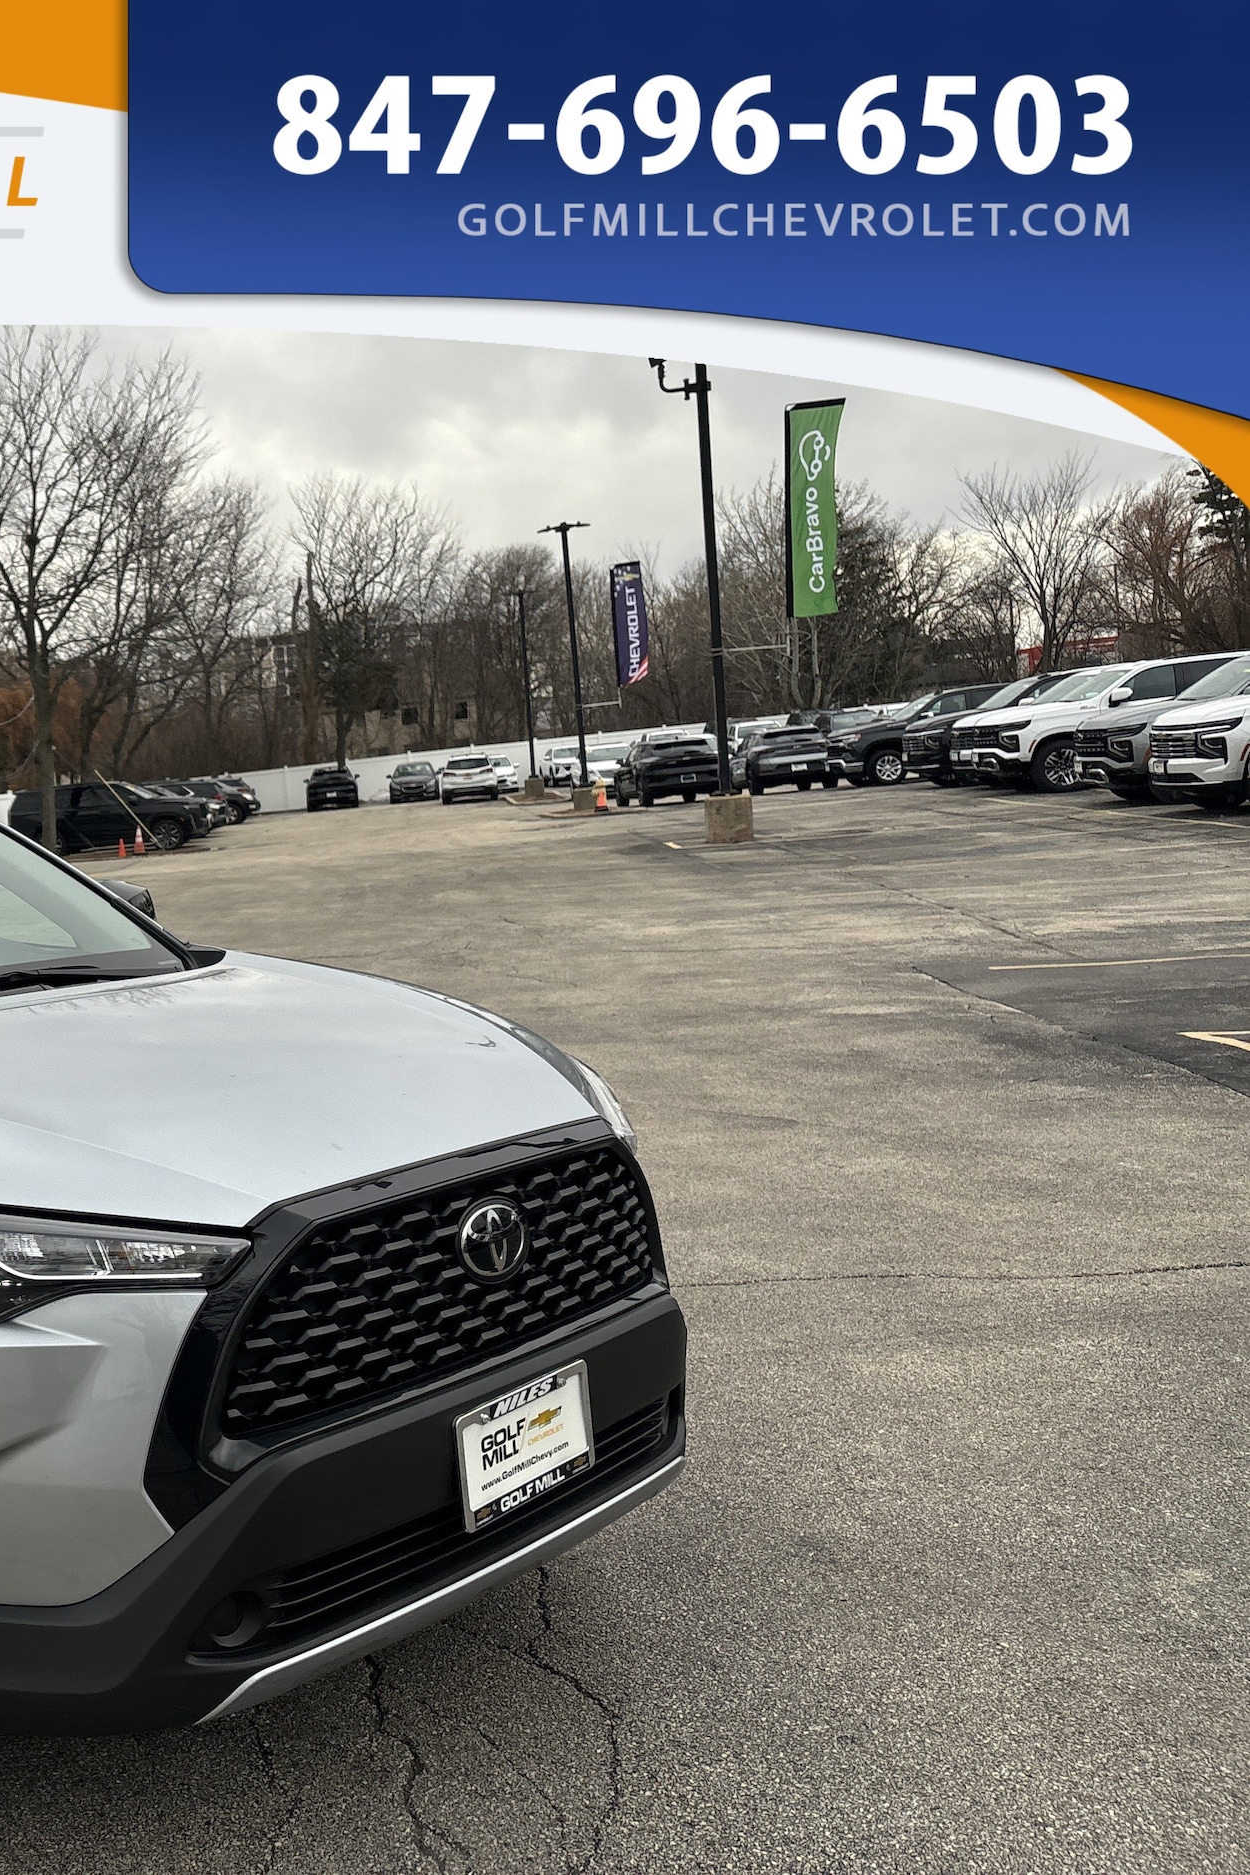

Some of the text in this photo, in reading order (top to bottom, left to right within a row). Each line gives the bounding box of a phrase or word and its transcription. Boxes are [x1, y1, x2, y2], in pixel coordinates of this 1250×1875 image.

[805, 486, 826, 594] CarBravo
[625, 585, 641, 678] CHEVROLET
[493, 1376, 554, 1420] NILES
[481, 1417, 526, 1454] GOLF
[482, 1438, 520, 1471] MILL
[480, 1440, 570, 1492] www.GolfMillChevy.com
[499, 1483, 534, 1513] GOLF
[535, 1468, 566, 1495] MILL
